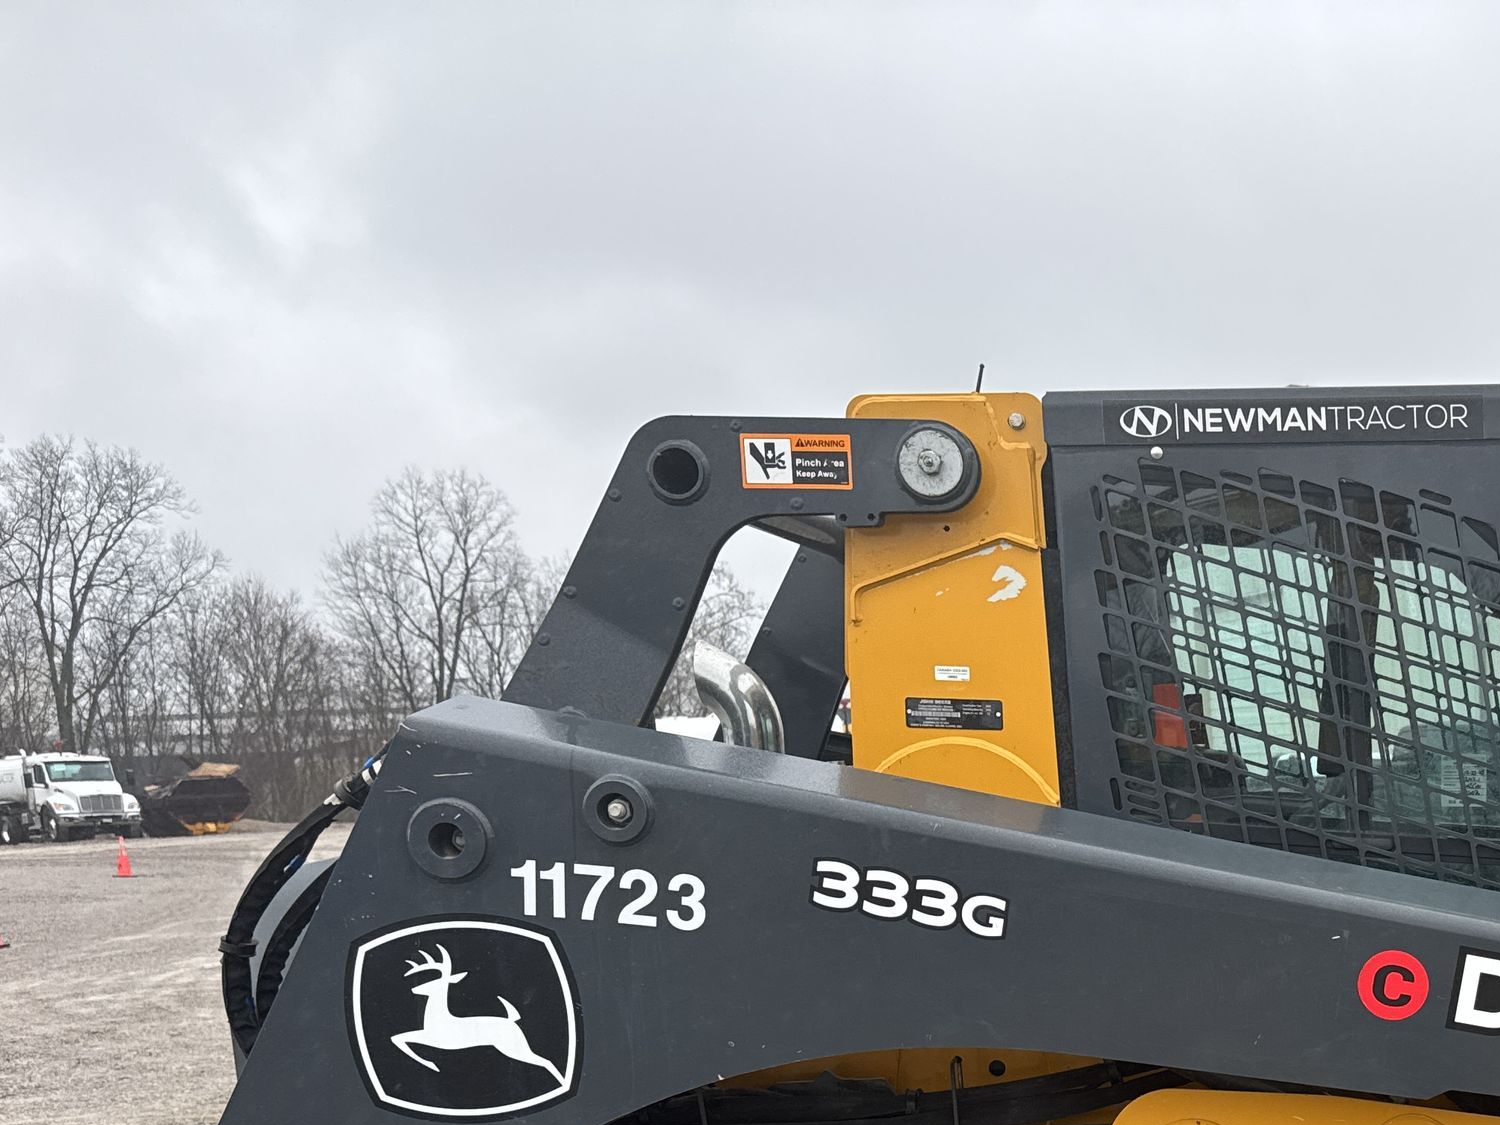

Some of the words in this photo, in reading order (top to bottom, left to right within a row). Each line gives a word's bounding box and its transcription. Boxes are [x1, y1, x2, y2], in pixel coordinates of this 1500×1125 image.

[1183, 403, 1469, 433] NEWMANTRACTOR
[804, 439, 845, 448] WARNING
[795, 458, 821, 467] Pinch
[796, 470, 816, 479] Keep
[510, 859, 707, 931] 11723
[812, 860, 1007, 937] 333G
[1372, 964, 1416, 1008] C
